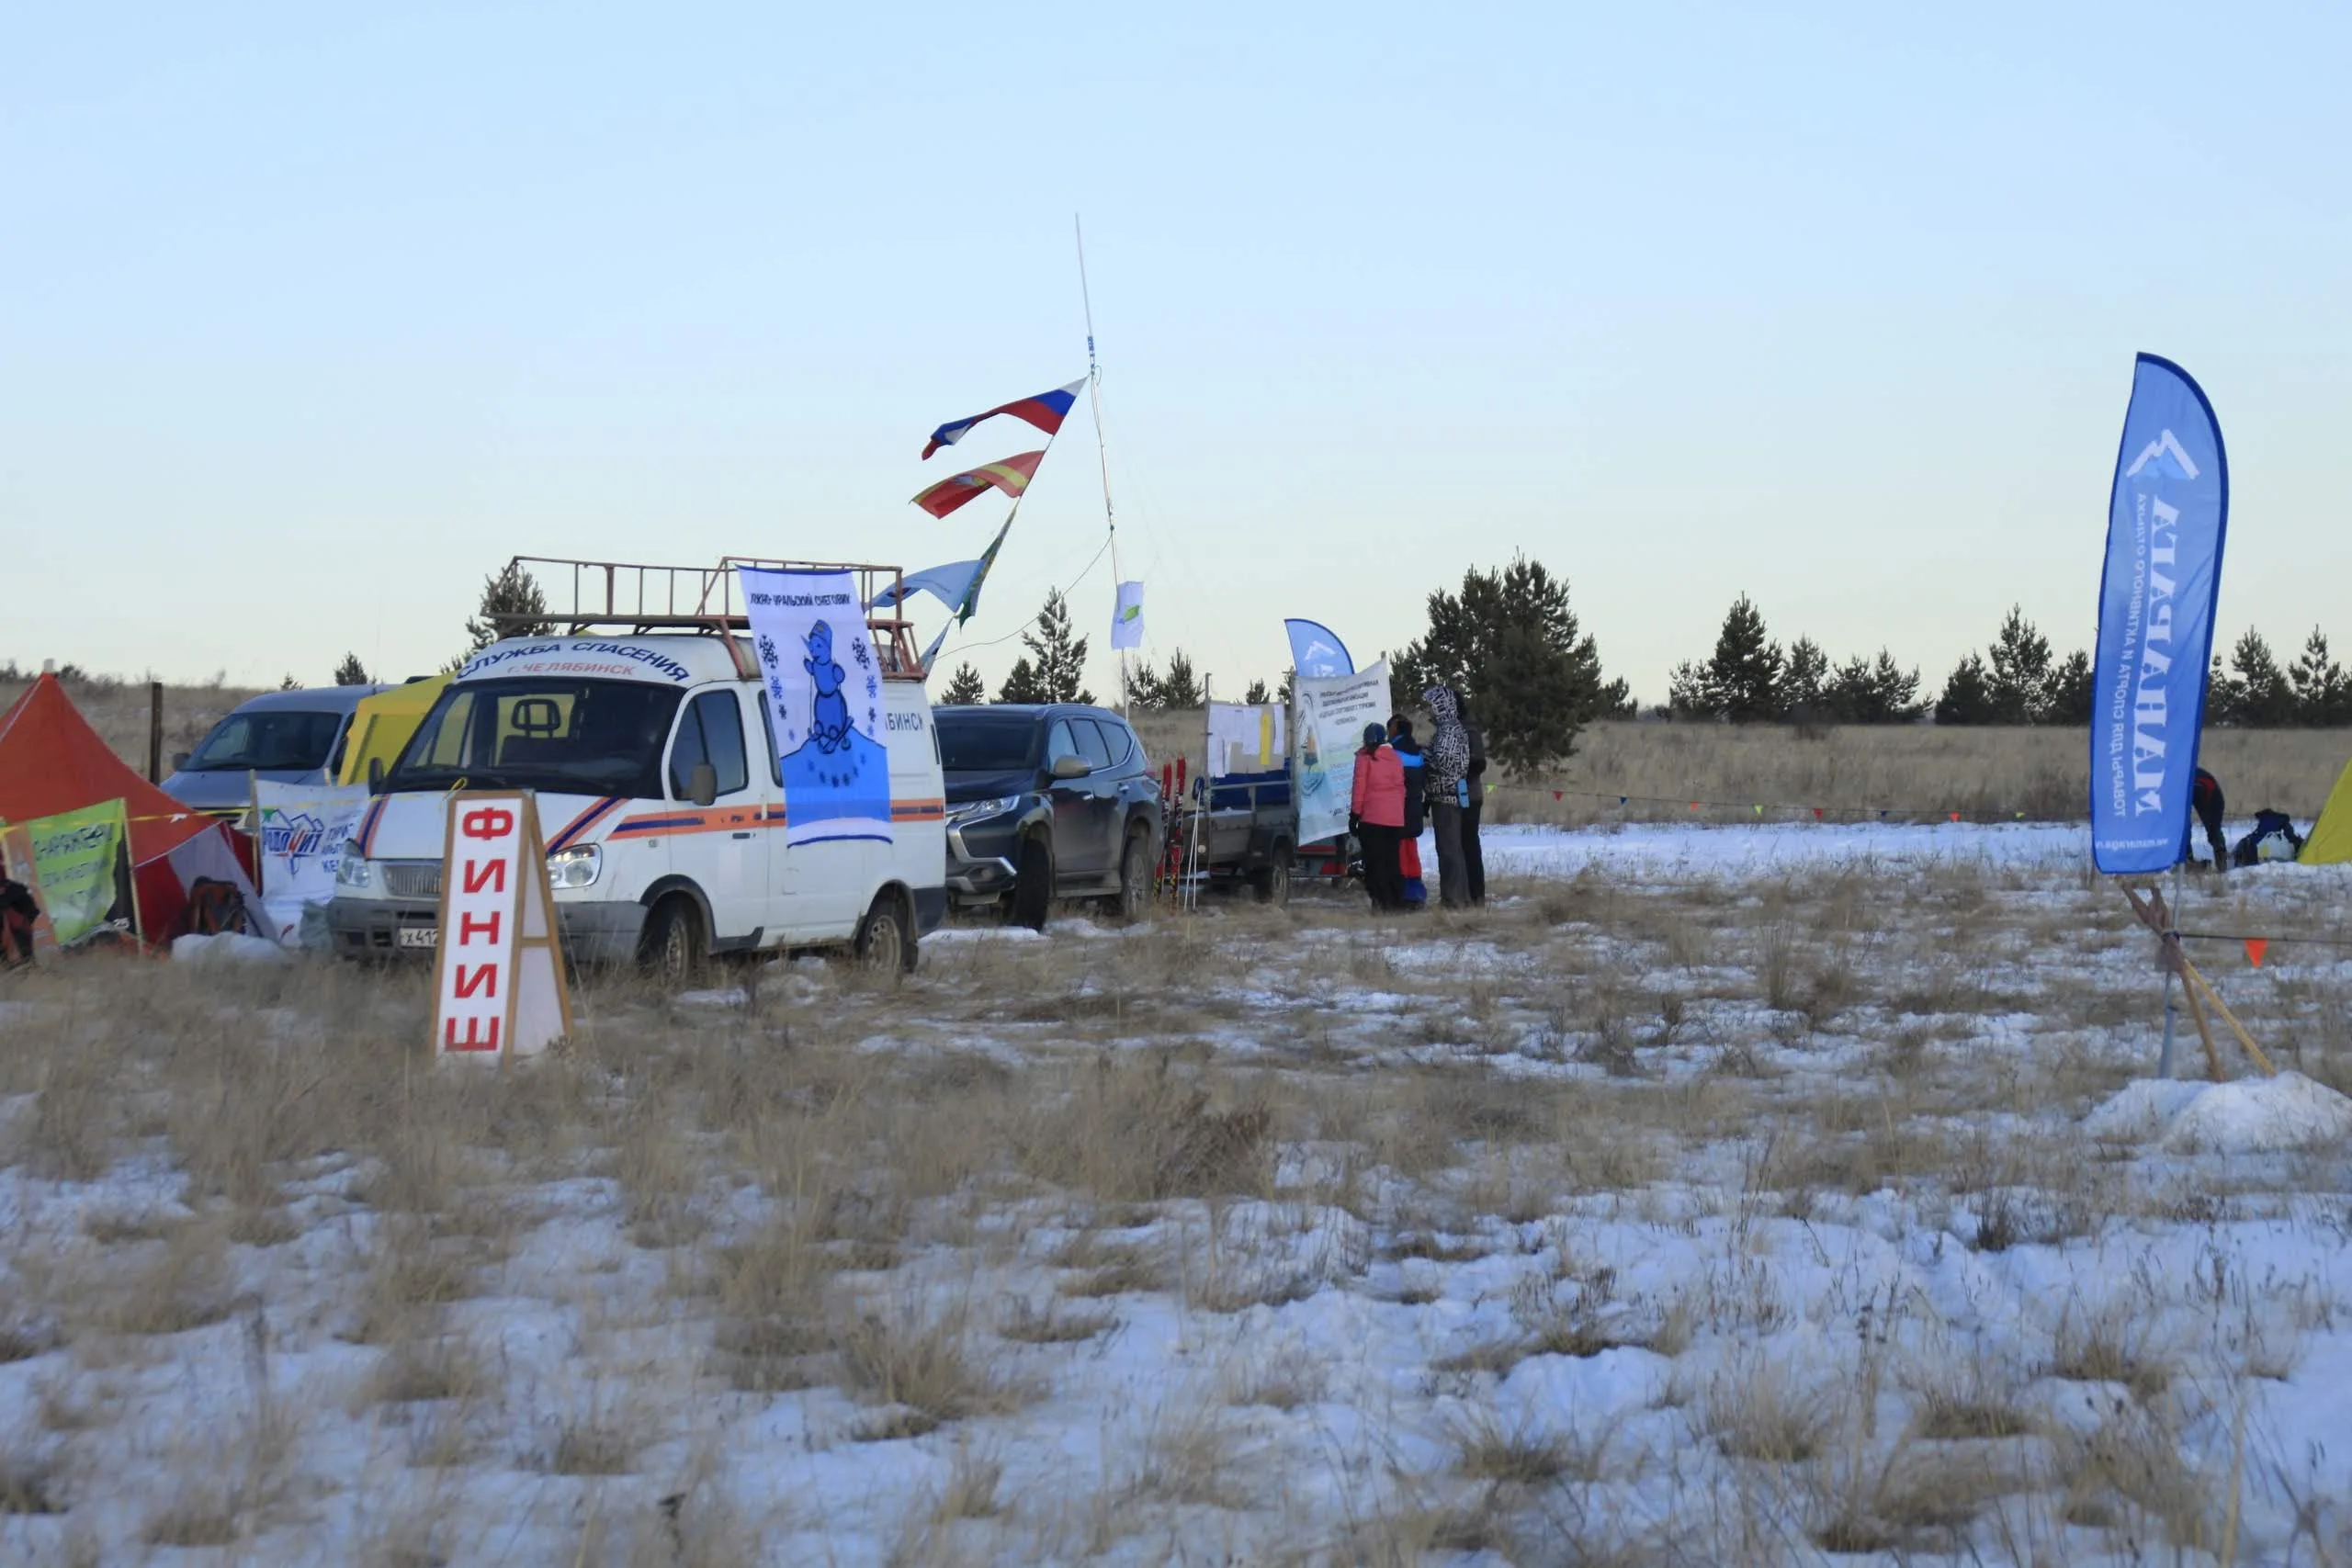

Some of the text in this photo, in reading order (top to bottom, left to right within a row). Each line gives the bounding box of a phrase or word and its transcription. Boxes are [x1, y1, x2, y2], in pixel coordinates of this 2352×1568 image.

[456, 642, 690, 682] СЛУЖБА СПАСЕНИЯ
[444, 807, 514, 1053] ФИНИШ
